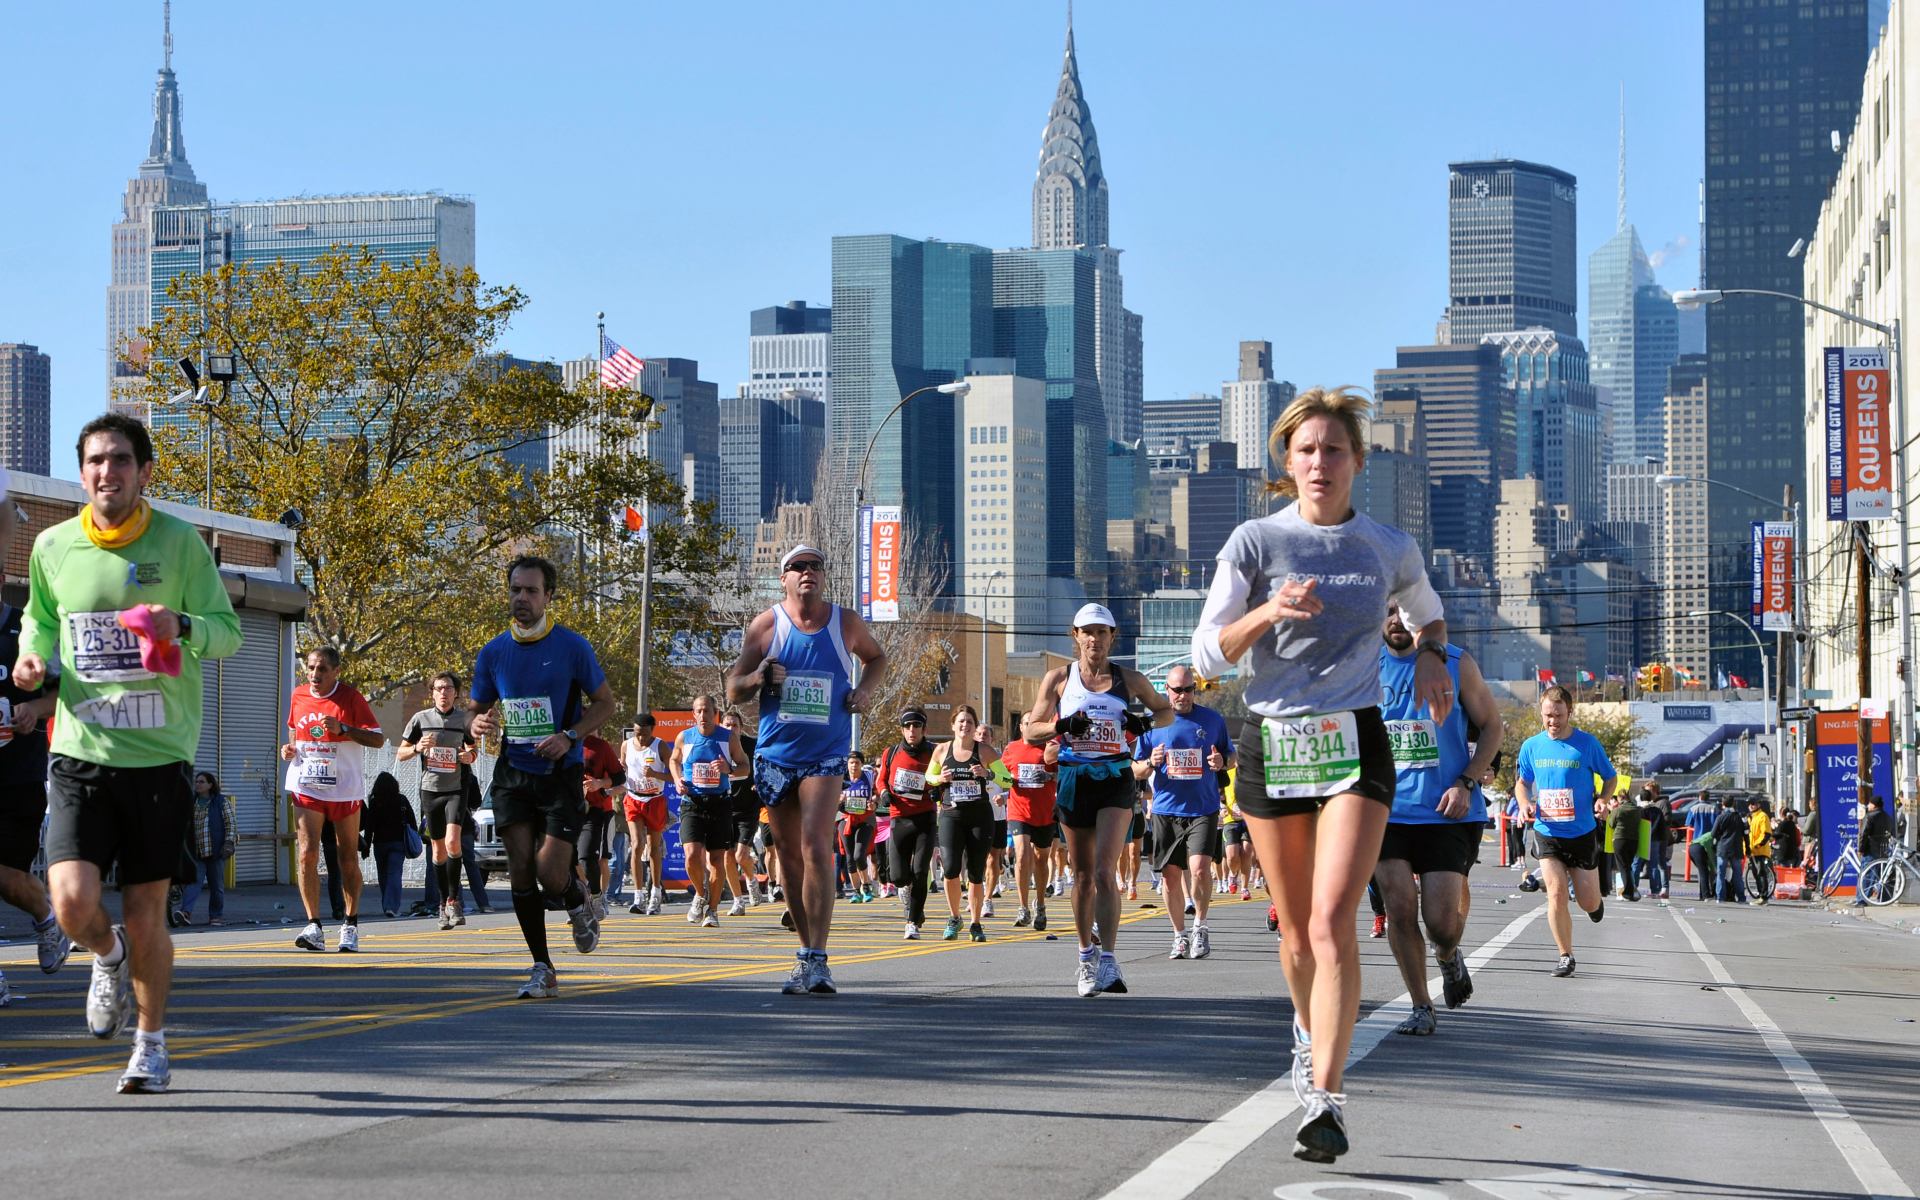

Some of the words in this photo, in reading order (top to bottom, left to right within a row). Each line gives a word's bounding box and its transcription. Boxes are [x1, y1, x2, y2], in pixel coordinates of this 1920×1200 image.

[1849, 358, 1884, 367] 2011
[1827, 353, 1841, 404] MARATHON
[1828, 406, 1841, 427] CITY
[1857, 374, 1881, 485] QUEENS
[1829, 428, 1842, 454] YORK
[1829, 455, 1842, 477] NEW
[1830, 479, 1842, 495] ING
[1830, 497, 1843, 515] THE
[876, 513, 899, 521] 2011
[862, 511, 872, 545] MARATHON
[862, 546, 871, 561] CITY
[878, 524, 894, 598] QUEENS
[862, 561, 870, 577] YORK
[1771, 540, 1786, 609] QUEENS
[862, 578, 870, 593] NEW
[1328, 574, 1347, 585] TO
[1347, 574, 1376, 586] RUN
[1753, 573, 1762, 588] YORK
[862, 593, 870, 605] ING
[1753, 589, 1761, 603] NEW
[861, 605, 870, 618] THE
[84, 616, 114, 628] ING
[1753, 615, 1761, 625] THE
[790, 680, 810, 688] ING
[786, 687, 824, 704] 19-631
[1382, 679, 1415, 707] DA
[510, 702, 529, 710] ING
[508, 708, 548, 725] 20-048
[1666, 708, 1692, 718] WATER'S
[1692, 708, 1709, 719] EDGE
[1281, 723, 1316, 736] ING
[1388, 724, 1410, 732] ING
[1824, 721, 1841, 729] ING
[1277, 731, 1347, 763] 17-344
[1171, 757, 1198, 766] 15-780
[1827, 755, 1859, 768] ING
[308, 765, 328, 776] 8-141
[1270, 770, 1321, 779] MARATHON
[900, 777, 919, 788] 8-005
[954, 786, 978, 795] 49-948
[1543, 798, 1570, 808] 32-943
